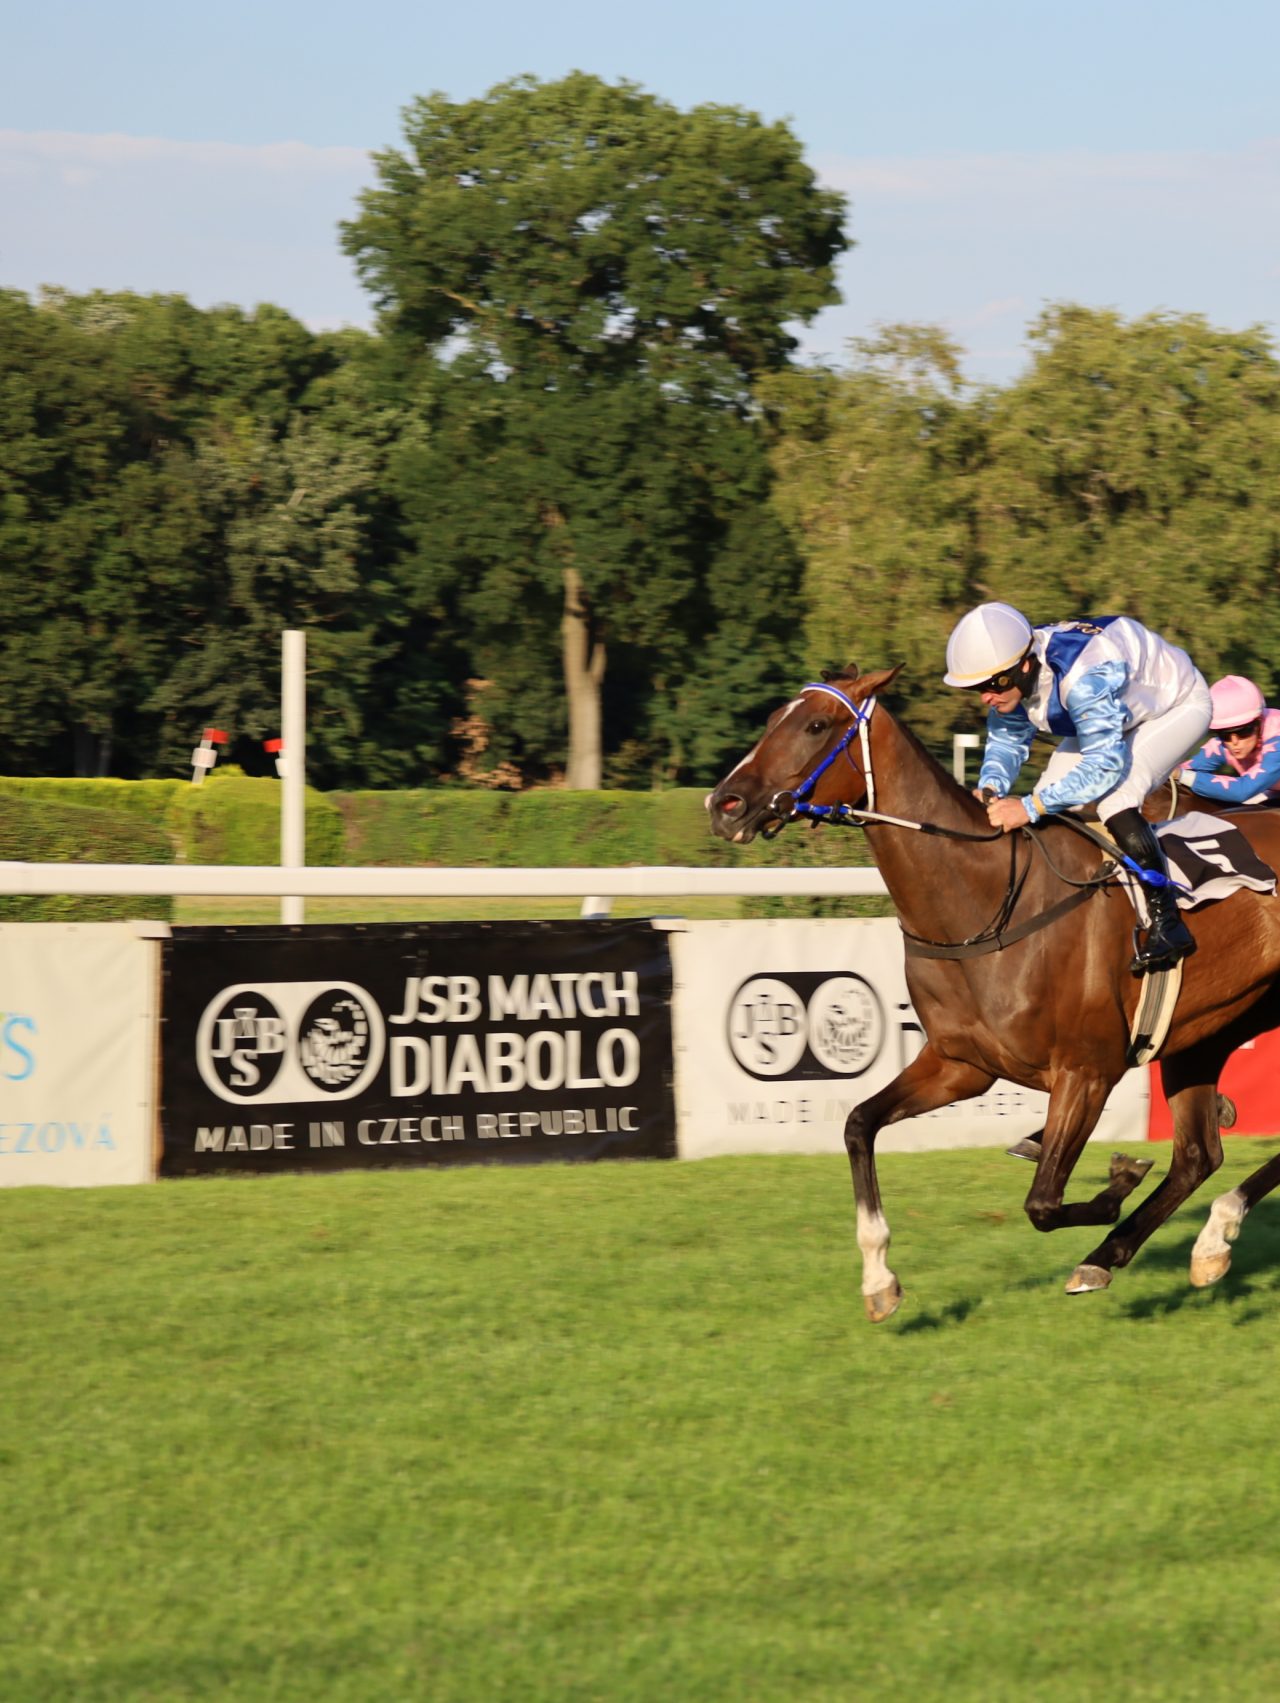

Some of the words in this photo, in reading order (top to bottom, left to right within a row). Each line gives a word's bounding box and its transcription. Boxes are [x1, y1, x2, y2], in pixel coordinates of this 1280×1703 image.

[388, 975, 482, 1024] JSB
[488, 971, 640, 1021] MATCH
[389, 1028, 640, 1097] DIABOLO
[195, 1123, 295, 1152] MADE
[309, 1121, 345, 1148] IN
[357, 1113, 465, 1145] CZECH
[476, 1106, 640, 1139] REPUBLIC
